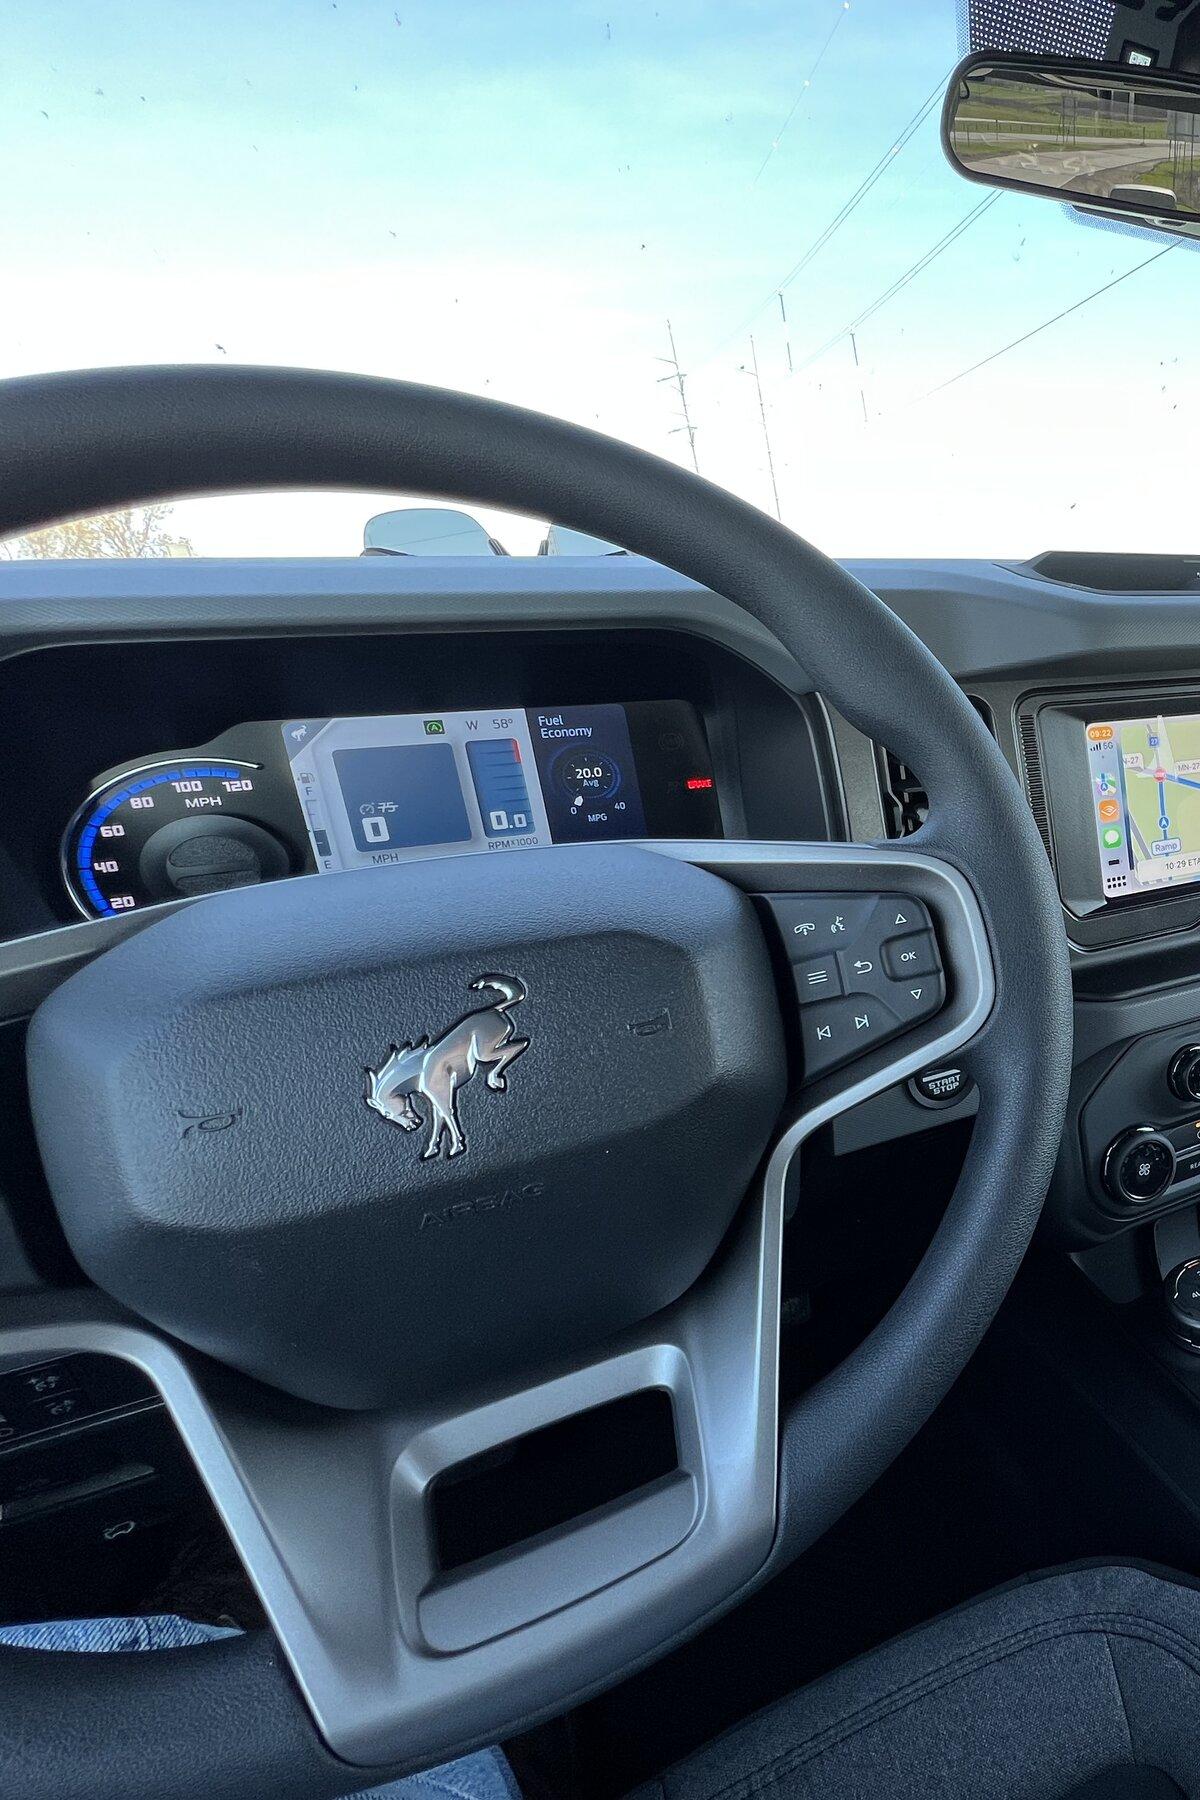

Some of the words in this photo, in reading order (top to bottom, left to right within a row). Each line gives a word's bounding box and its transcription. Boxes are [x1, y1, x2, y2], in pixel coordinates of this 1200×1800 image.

[466, 721, 478, 731] W
[492, 718, 513, 729] 58°
[538, 715, 563, 727] Fuel
[541, 727, 592, 739] Economy
[575, 767, 602, 779] 20.0
[172, 781, 203, 793] 100
[222, 780, 253, 792] 120
[583, 780, 600, 788] Avg
[306, 787, 312, 796] F
[130, 796, 155, 809] 80
[185, 796, 223, 808] MPH
[614, 802, 626, 810] 40
[570, 806, 577, 814] 0
[490, 810, 527, 830] 0.0
[588, 813, 608, 822] MPG
[100, 825, 125, 838] 60
[362, 816, 390, 843] 0
[1155, 843, 1178, 852] Ramp
[324, 860, 332, 869] E
[372, 853, 399, 864] MPH
[94, 861, 119, 873] 40
[110, 896, 135, 909] 20
[901, 951, 917, 962] OK
[928, 1074, 960, 1089] START
[934, 1082, 960, 1095] STOP
